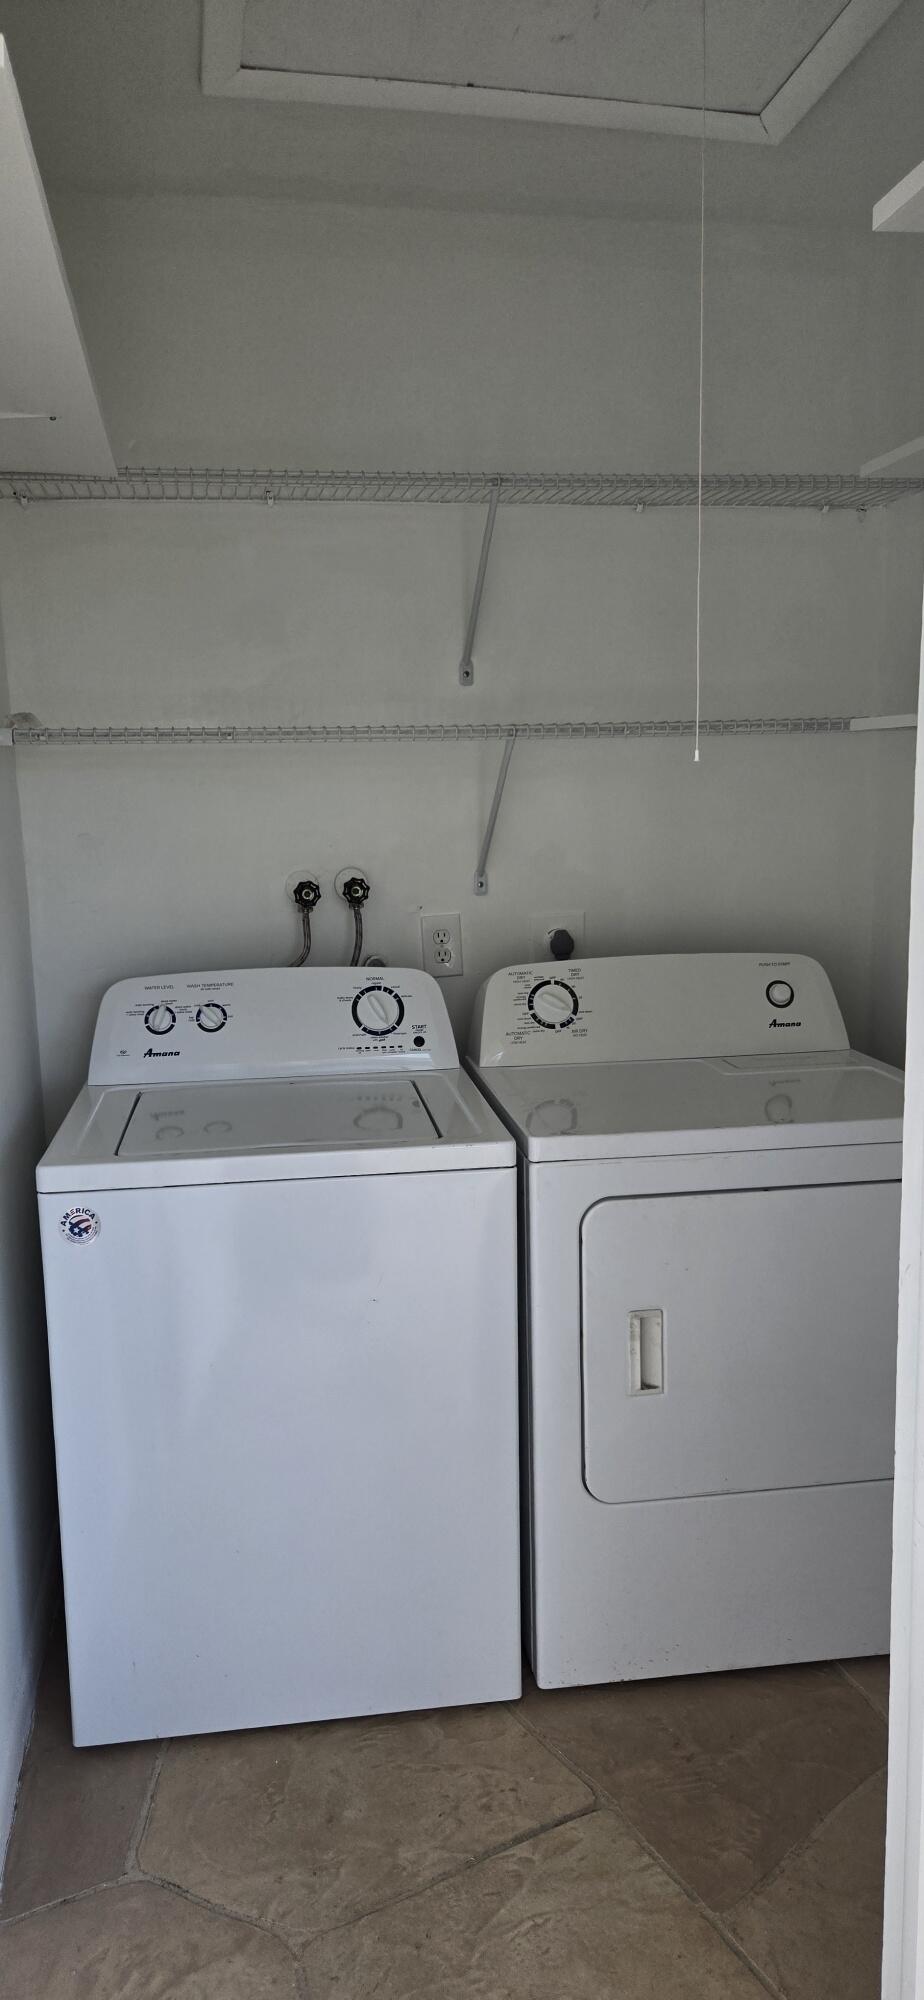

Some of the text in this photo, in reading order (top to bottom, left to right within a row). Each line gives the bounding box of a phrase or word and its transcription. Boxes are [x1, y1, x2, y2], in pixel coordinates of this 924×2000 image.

[768, 1018, 802, 1029] Amana
[143, 1047, 180, 1059] Amana
[60, 1207, 96, 1227] AMERICA
